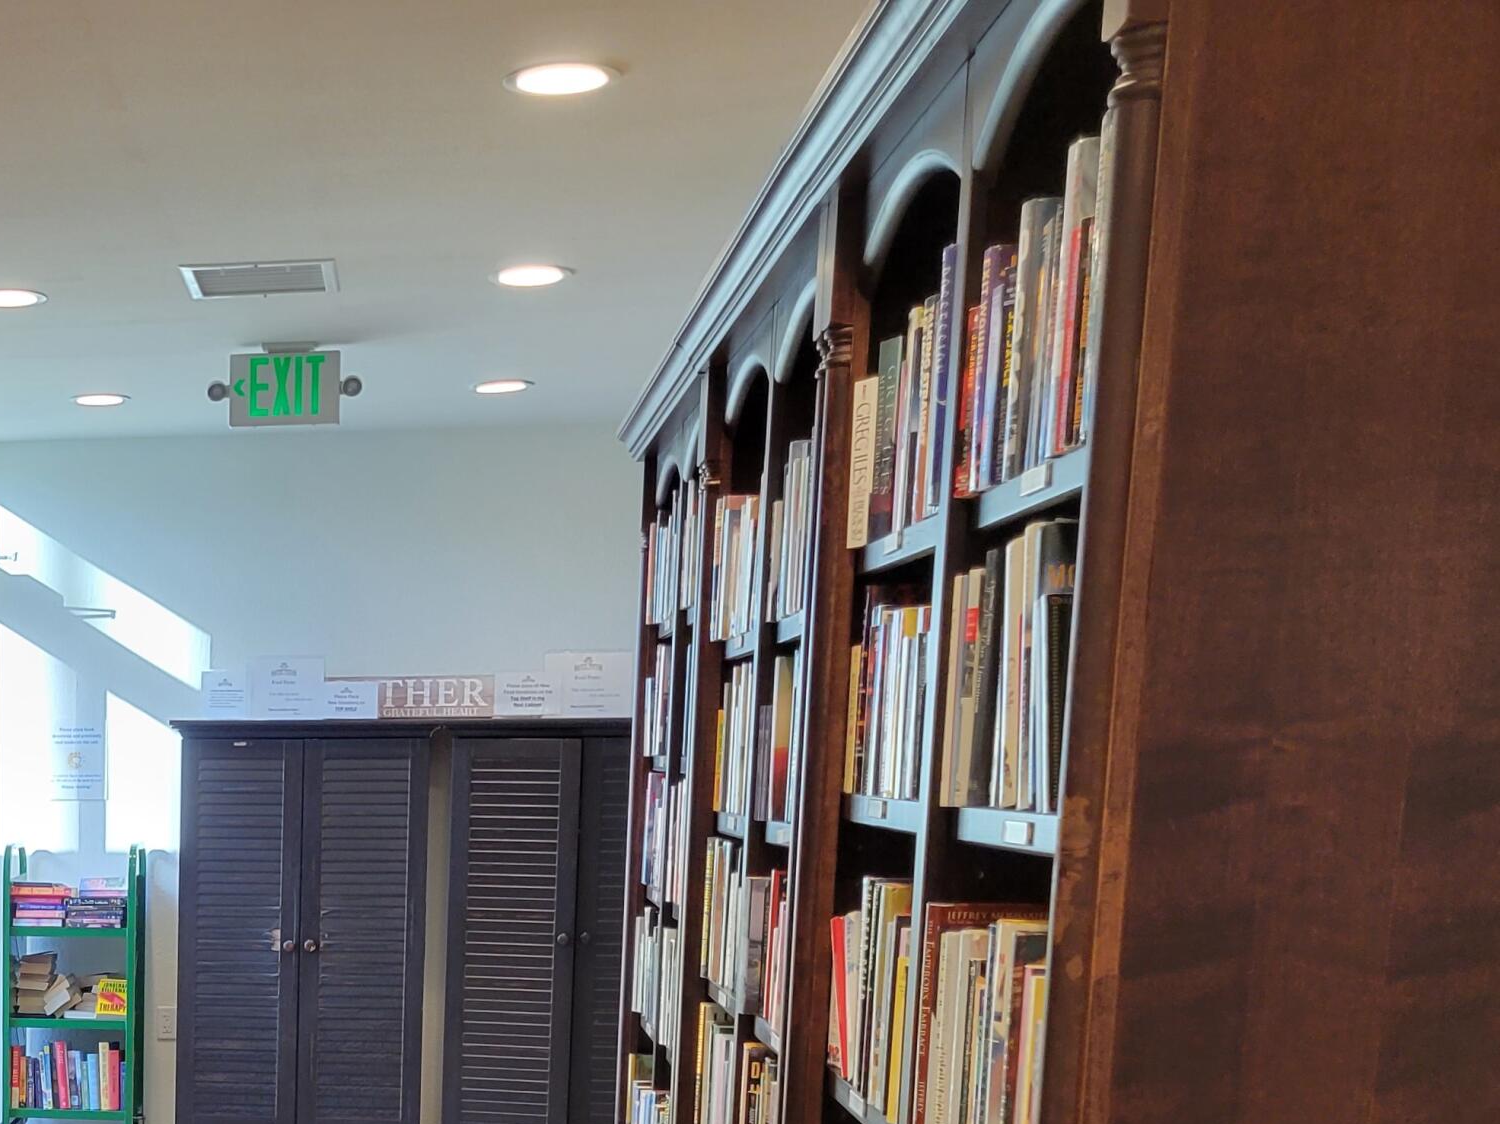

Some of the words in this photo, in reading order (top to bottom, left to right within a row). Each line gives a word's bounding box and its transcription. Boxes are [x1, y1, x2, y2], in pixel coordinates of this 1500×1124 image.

[979, 259, 992, 297] EXIT
[250, 355, 325, 417] EXIT
[853, 401, 872, 453] GREG
[852, 454, 869, 487] ILES
[380, 678, 488, 708] THER
[382, 708, 439, 718] GRATEFUL
